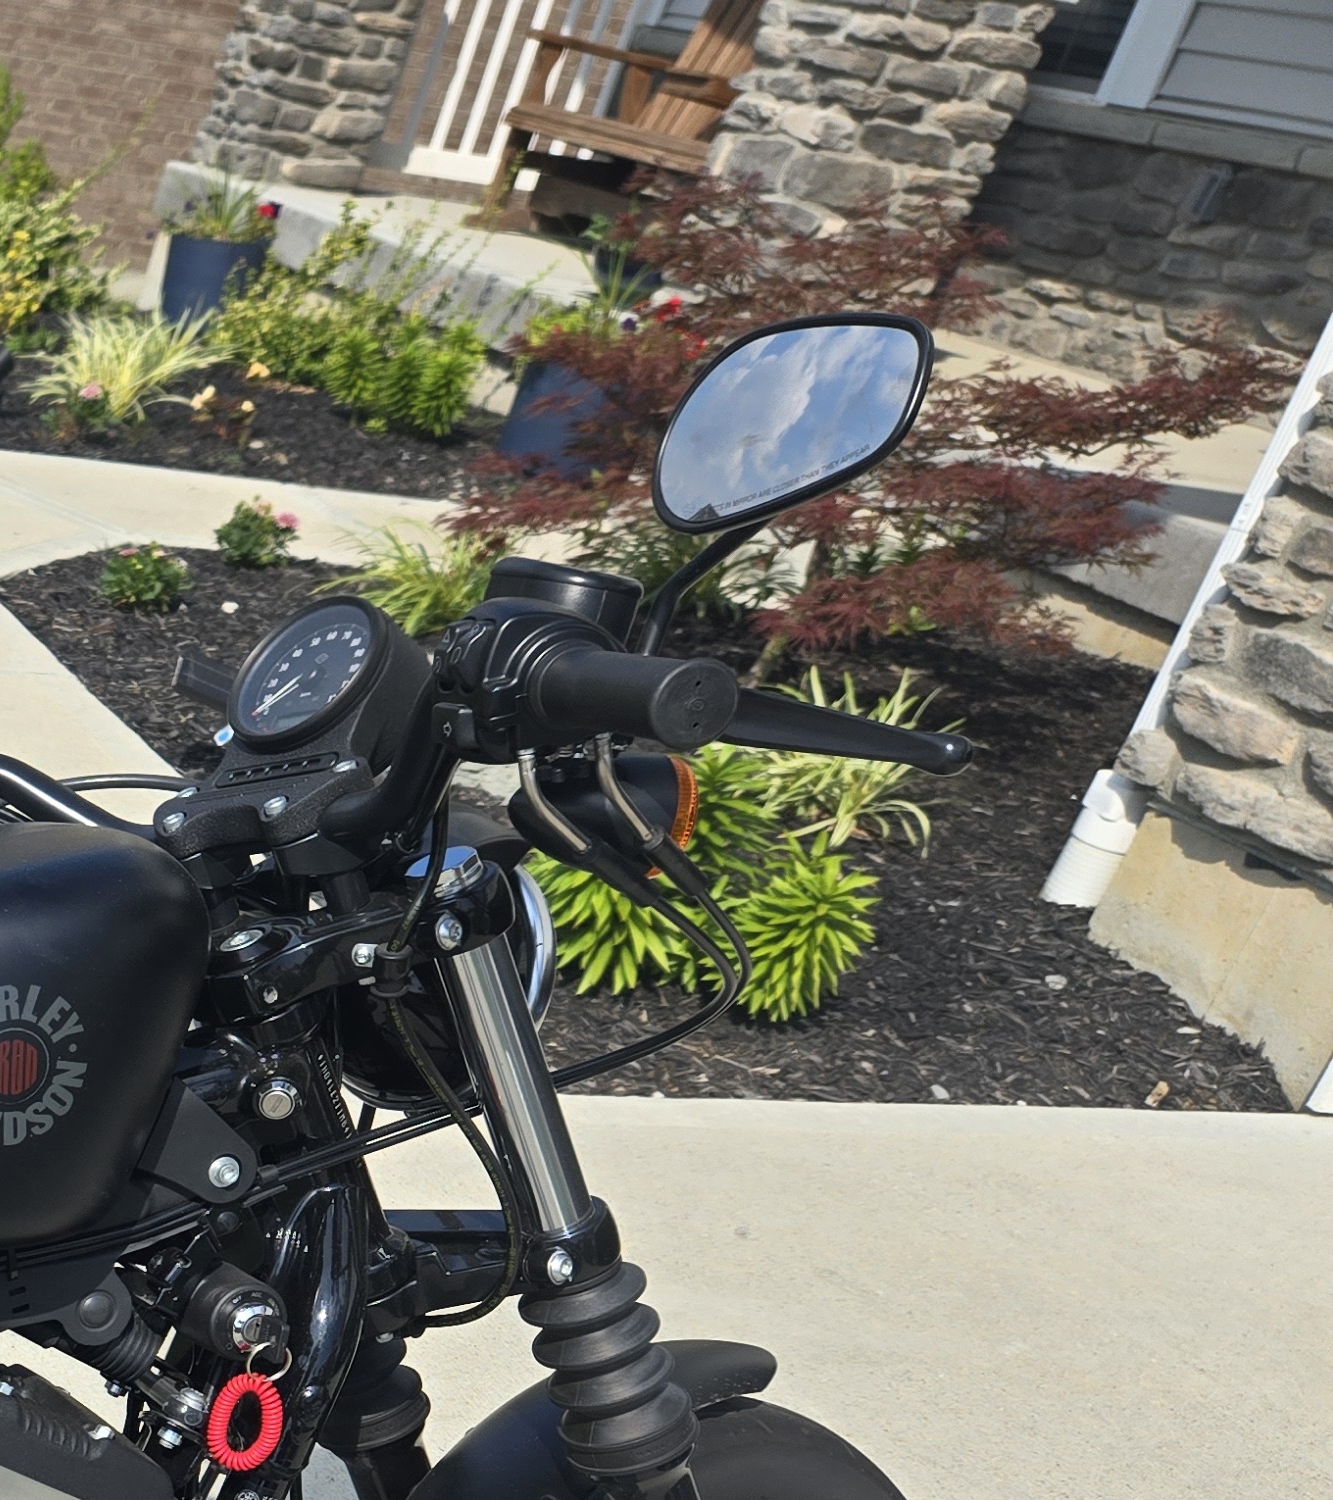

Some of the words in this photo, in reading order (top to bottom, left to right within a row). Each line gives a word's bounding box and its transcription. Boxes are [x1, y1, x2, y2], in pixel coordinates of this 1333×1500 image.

[759, 487, 772, 497] ARE
[801, 469, 820, 481] THAN
[821, 460, 840, 473] THEY
[841, 444, 870, 463] APPEAR
